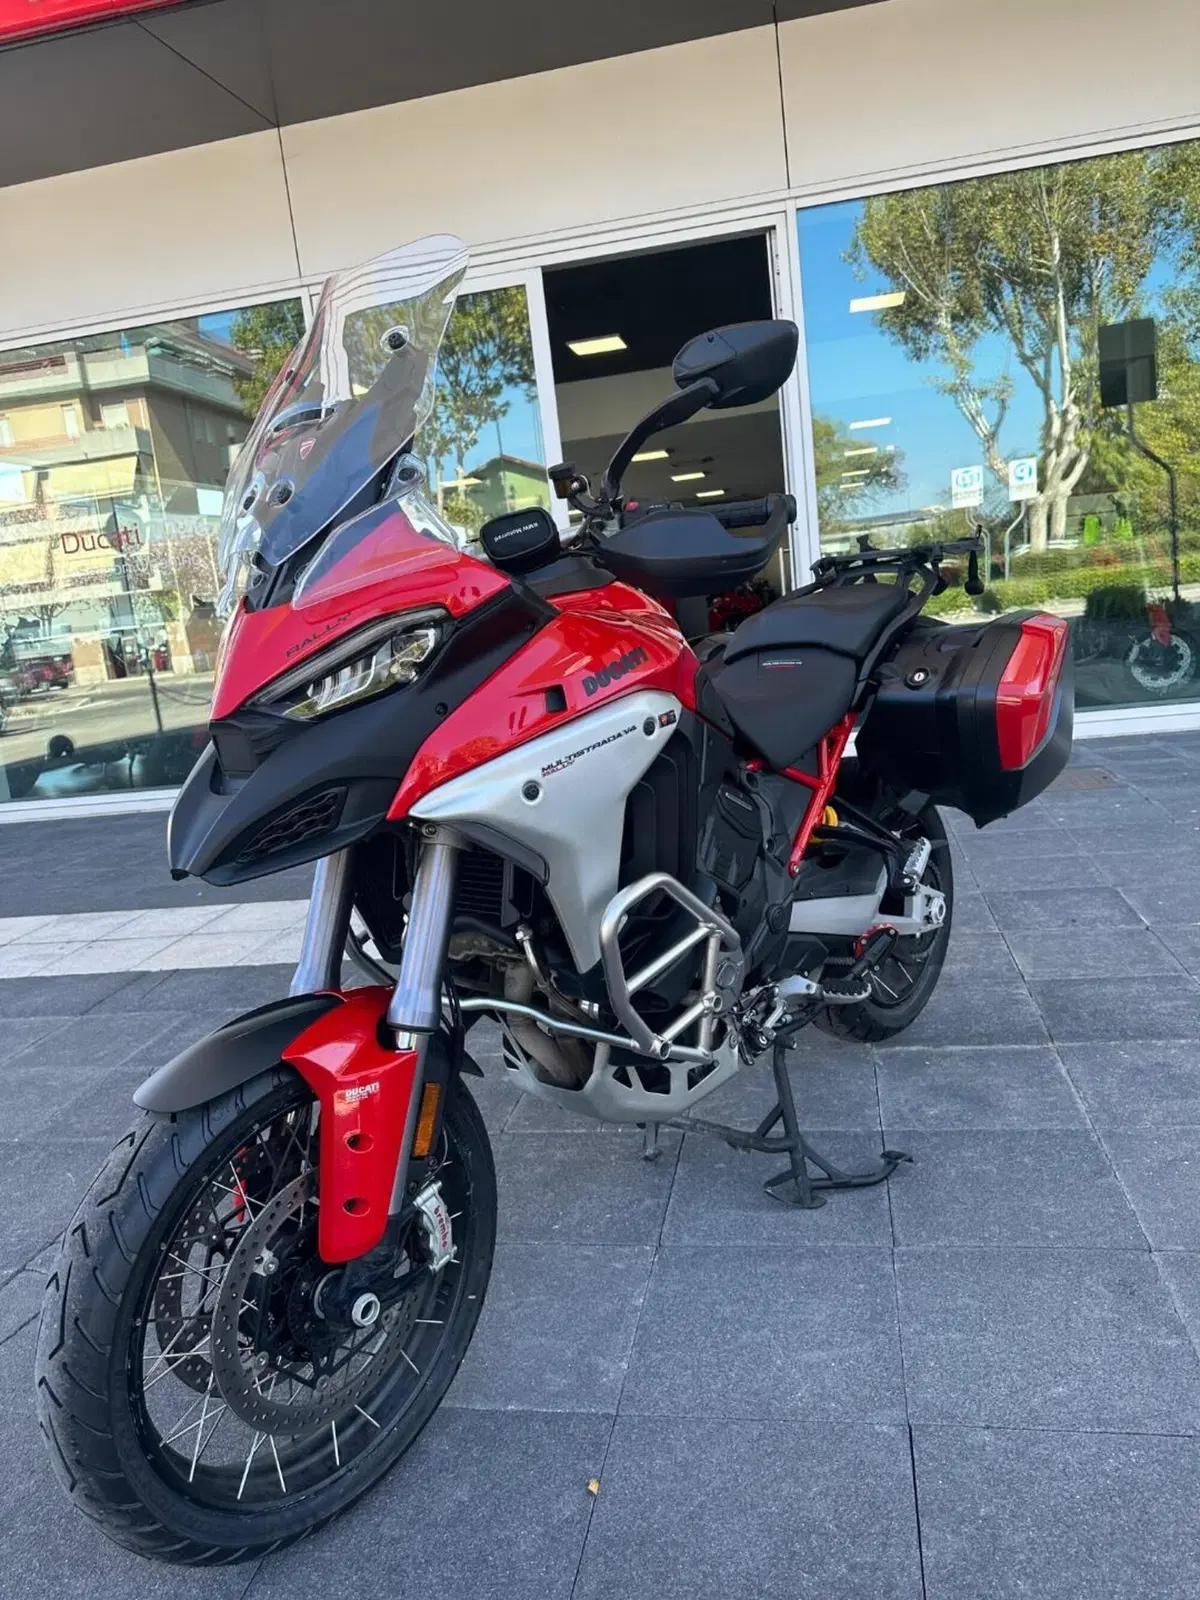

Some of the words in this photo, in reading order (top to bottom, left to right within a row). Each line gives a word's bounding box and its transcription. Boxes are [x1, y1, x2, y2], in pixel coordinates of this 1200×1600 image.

[61, 522, 143, 554] Ducati
[286, 609, 352, 657] RALLY
[582, 646, 649, 697] DUCATI
[541, 731, 623, 773] MULTISTRADA
[622, 724, 638, 736] V4
[345, 1081, 380, 1098] DUCATI
[433, 1205, 449, 1249] brembo
